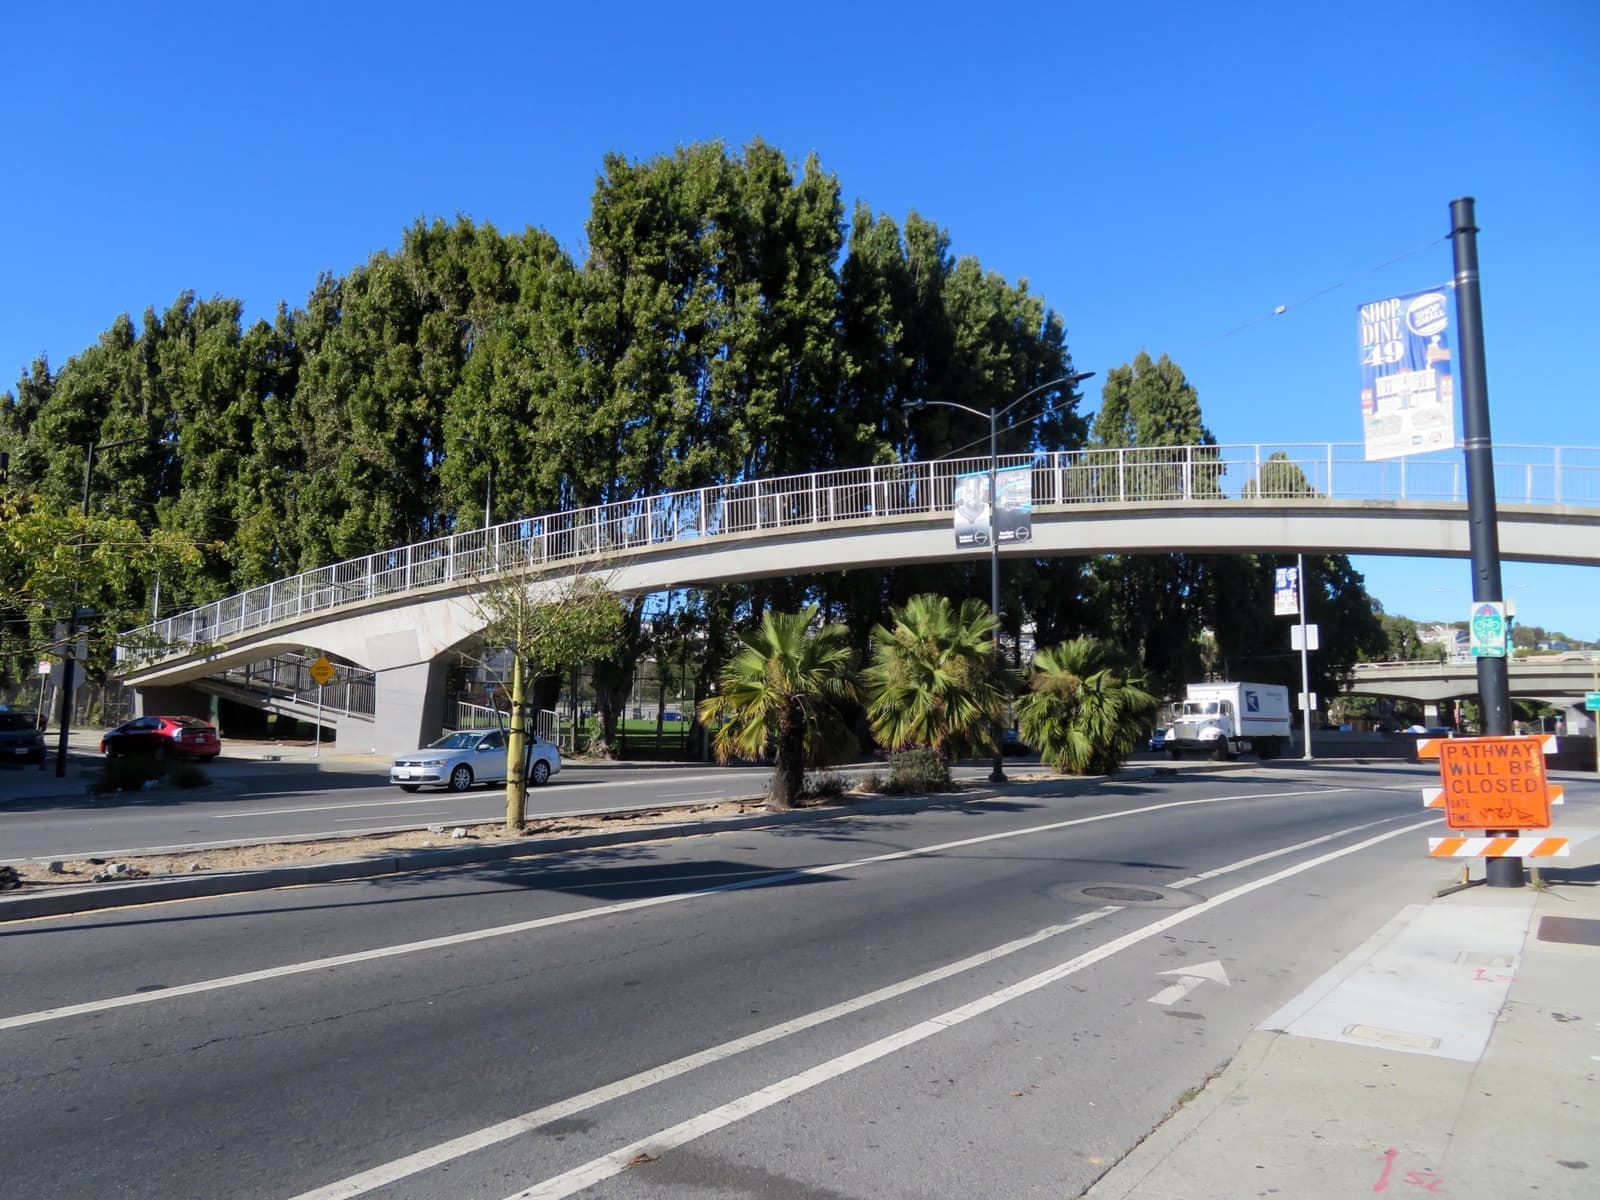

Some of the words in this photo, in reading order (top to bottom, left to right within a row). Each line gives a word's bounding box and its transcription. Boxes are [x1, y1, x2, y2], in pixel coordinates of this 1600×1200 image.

[1361, 298, 1401, 325] SHOP
[1362, 317, 1403, 347] DINE
[1363, 340, 1405, 367] 49
[1447, 744, 1534, 759] PATHWAY
[1450, 761, 1498, 776] WILL
[1452, 778, 1538, 794] CLOSED
[1450, 799, 1471, 809] DATE
